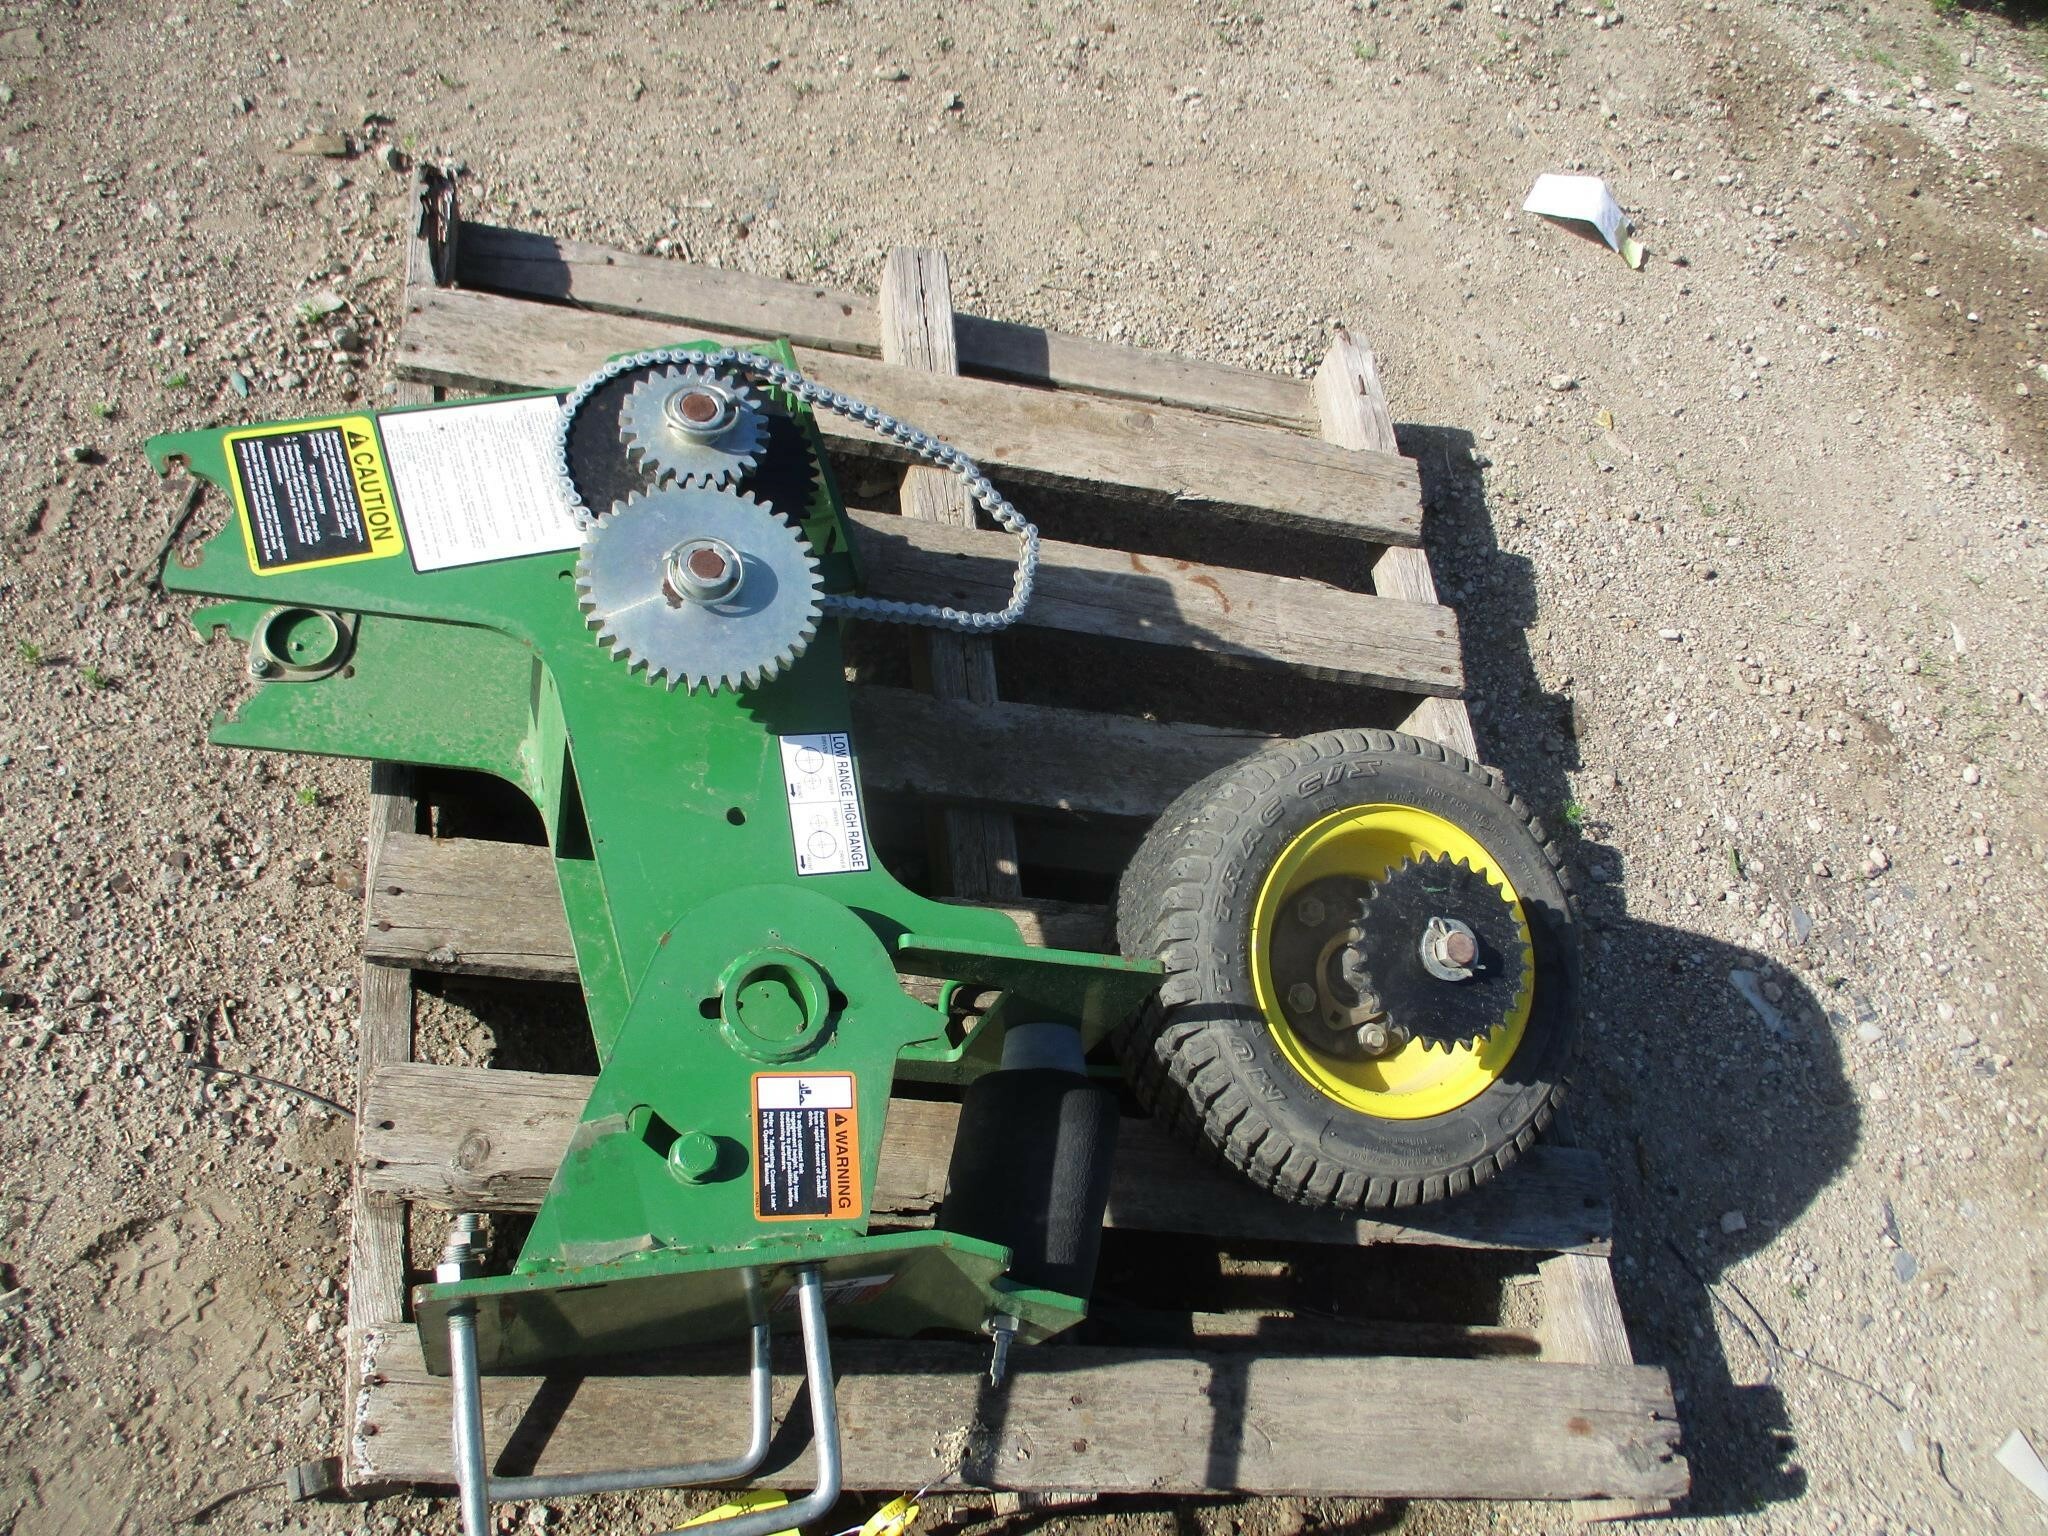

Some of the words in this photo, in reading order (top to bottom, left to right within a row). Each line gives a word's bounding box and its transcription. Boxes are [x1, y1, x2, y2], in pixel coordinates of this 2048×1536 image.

[332, 431, 344, 462] Agricultural
[294, 444, 302, 461] Select
[303, 486, 313, 511] chemical
[310, 464, 316, 473] TO
[312, 474, 320, 492] AVOID
[286, 445, 295, 464] Handle
[293, 476, 301, 492] apply
[304, 526, 313, 545] Follow
[316, 493, 325, 514] INJURY
[353, 451, 393, 540] CAUTION
[833, 736, 846, 757] LOW
[837, 761, 852, 796] RANGE
[844, 803, 857, 827] HIGH
[1425, 787, 1447, 800] NOT
[1450, 798, 1470, 813] FOR
[848, 831, 864, 867] RANGE
[836, 1130, 850, 1208] WARNING
